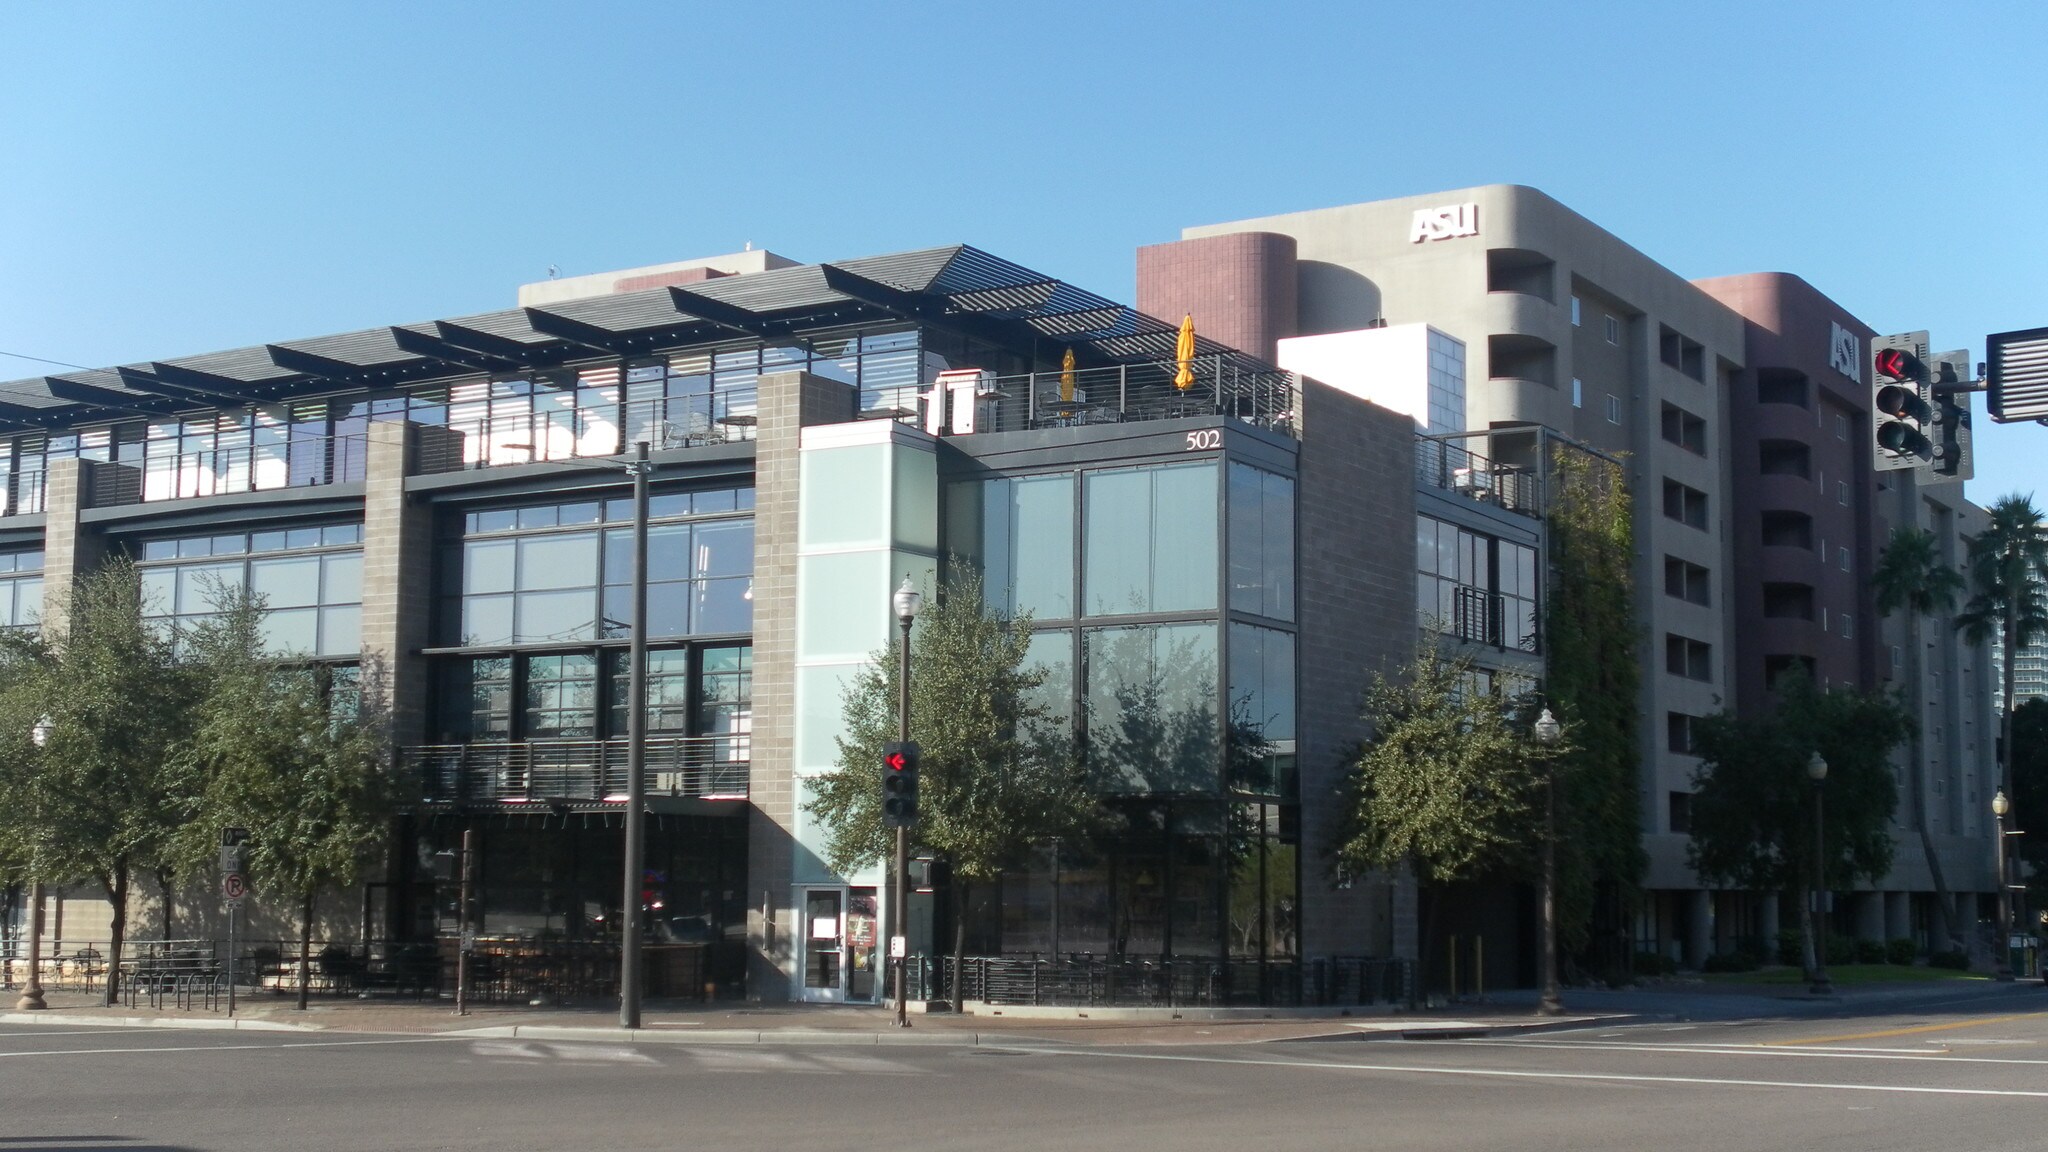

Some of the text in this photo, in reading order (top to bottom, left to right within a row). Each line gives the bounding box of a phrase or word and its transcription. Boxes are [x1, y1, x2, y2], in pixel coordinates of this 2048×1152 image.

[1409, 202, 1478, 243] ASU
[1829, 320, 1861, 385] ASU
[1186, 429, 1221, 451] 502
